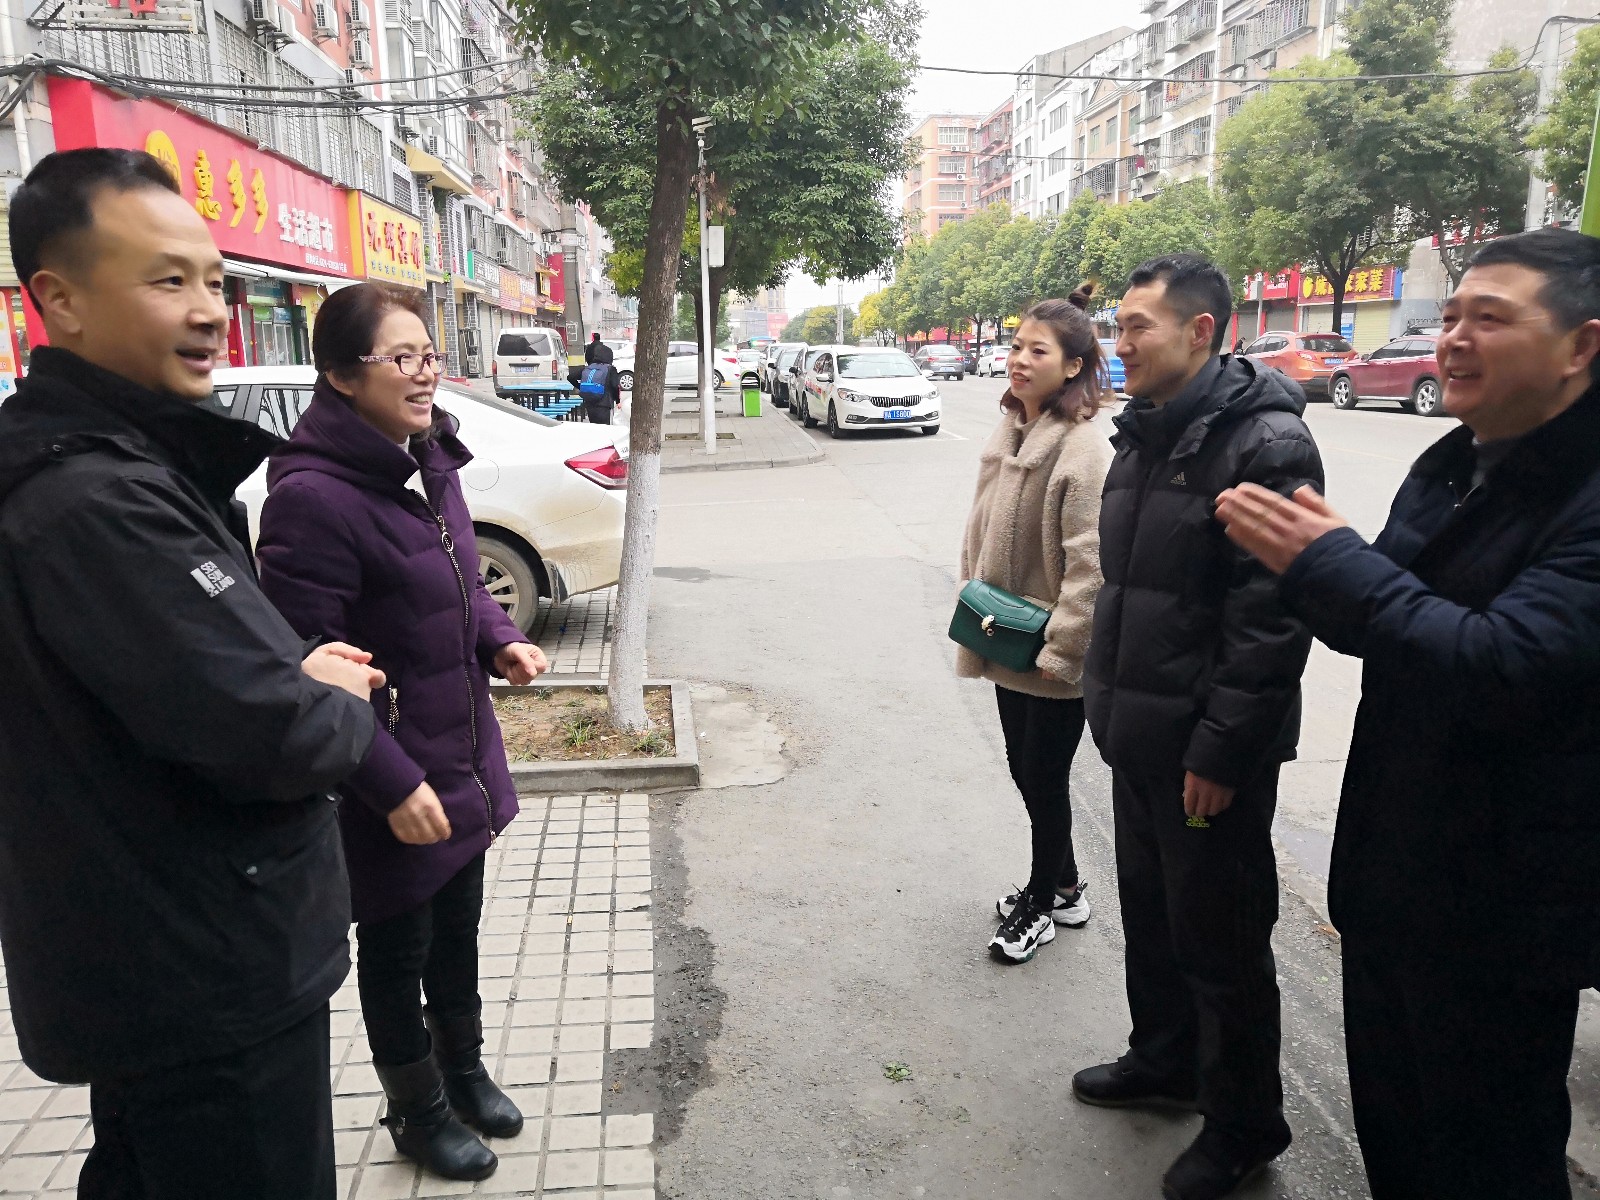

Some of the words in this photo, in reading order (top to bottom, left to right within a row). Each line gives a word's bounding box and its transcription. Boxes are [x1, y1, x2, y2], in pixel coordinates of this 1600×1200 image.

[194, 149, 269, 234] 惠多多
[278, 203, 334, 253] 生活超市
